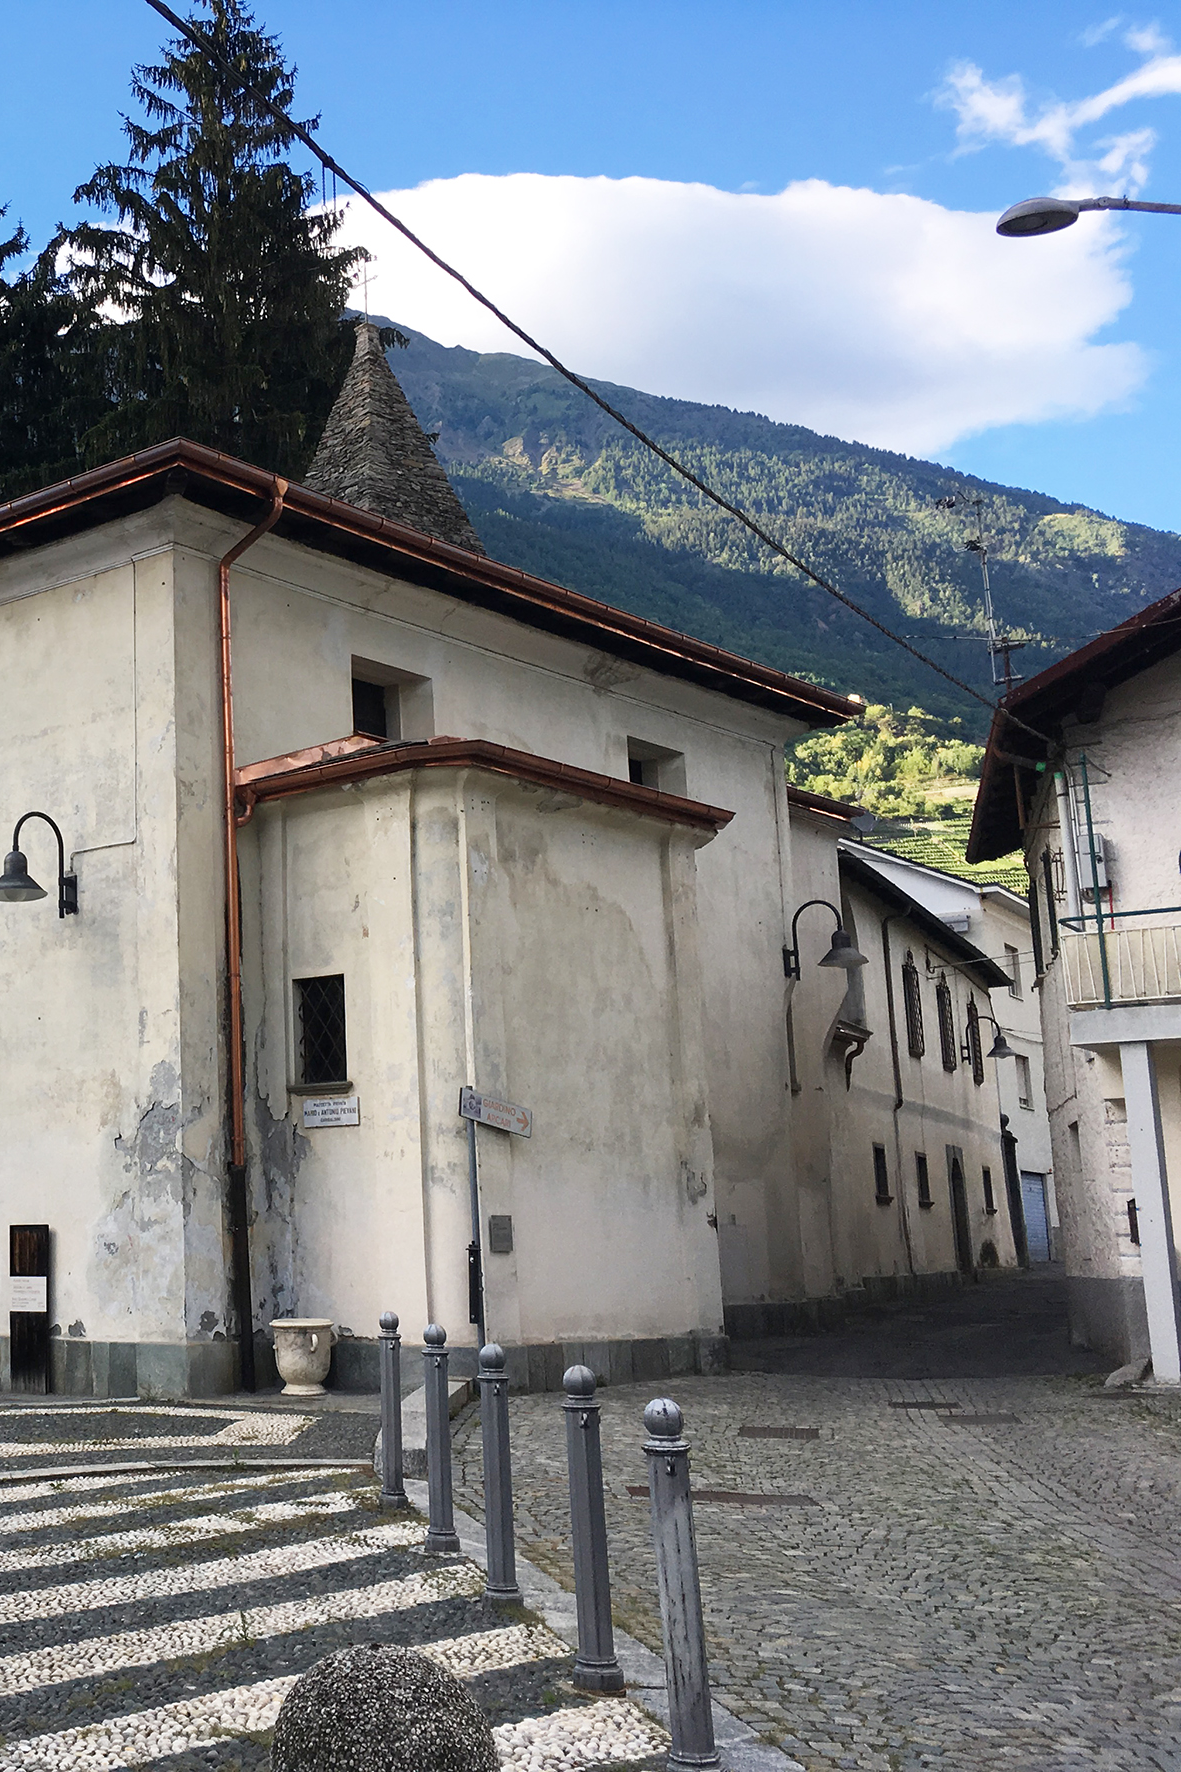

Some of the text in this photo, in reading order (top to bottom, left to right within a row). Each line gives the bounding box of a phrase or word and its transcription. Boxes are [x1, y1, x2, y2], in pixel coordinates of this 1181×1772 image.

[321, 1108, 339, 1116] ANTONIO
[483, 1098, 516, 1117] GIARDINO
[486, 1113, 512, 1128] ARCARI
